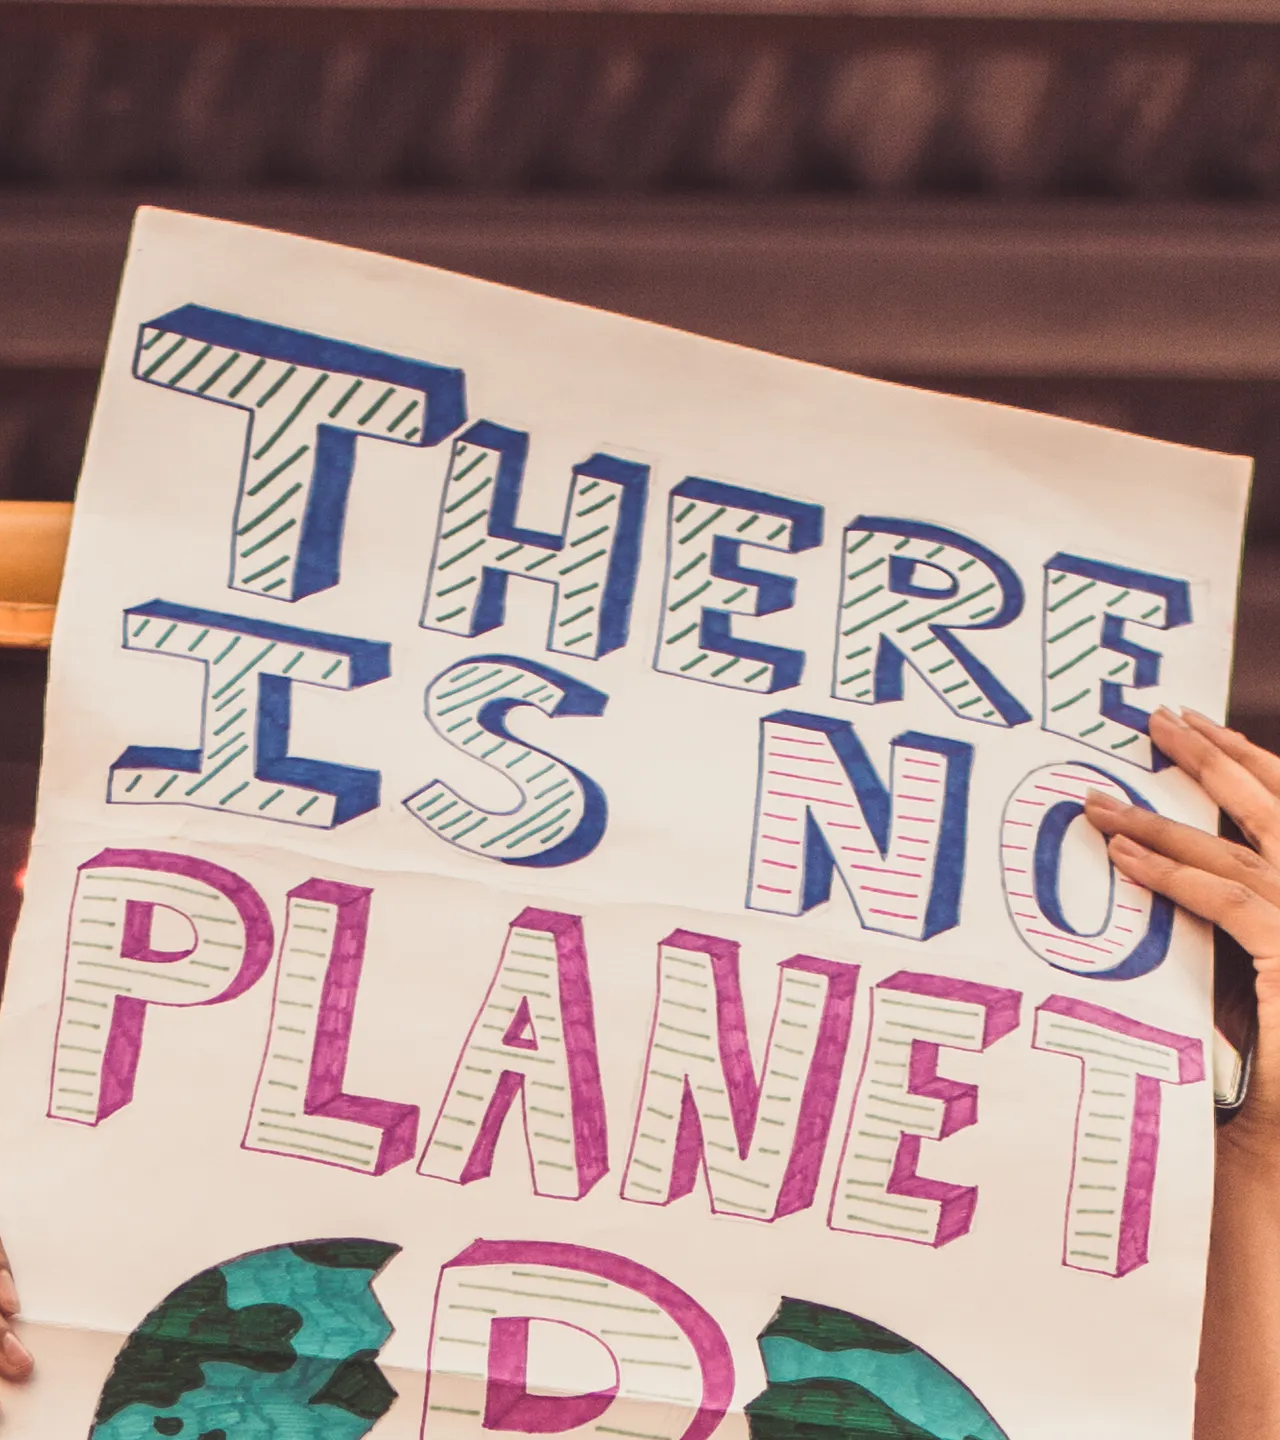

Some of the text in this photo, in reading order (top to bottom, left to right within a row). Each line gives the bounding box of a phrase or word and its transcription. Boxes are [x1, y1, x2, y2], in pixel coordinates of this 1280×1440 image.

[132, 302, 1194, 772] THERE
[105, 598, 1176, 981] IS NO
[45, 847, 1206, 1278] PLANET
